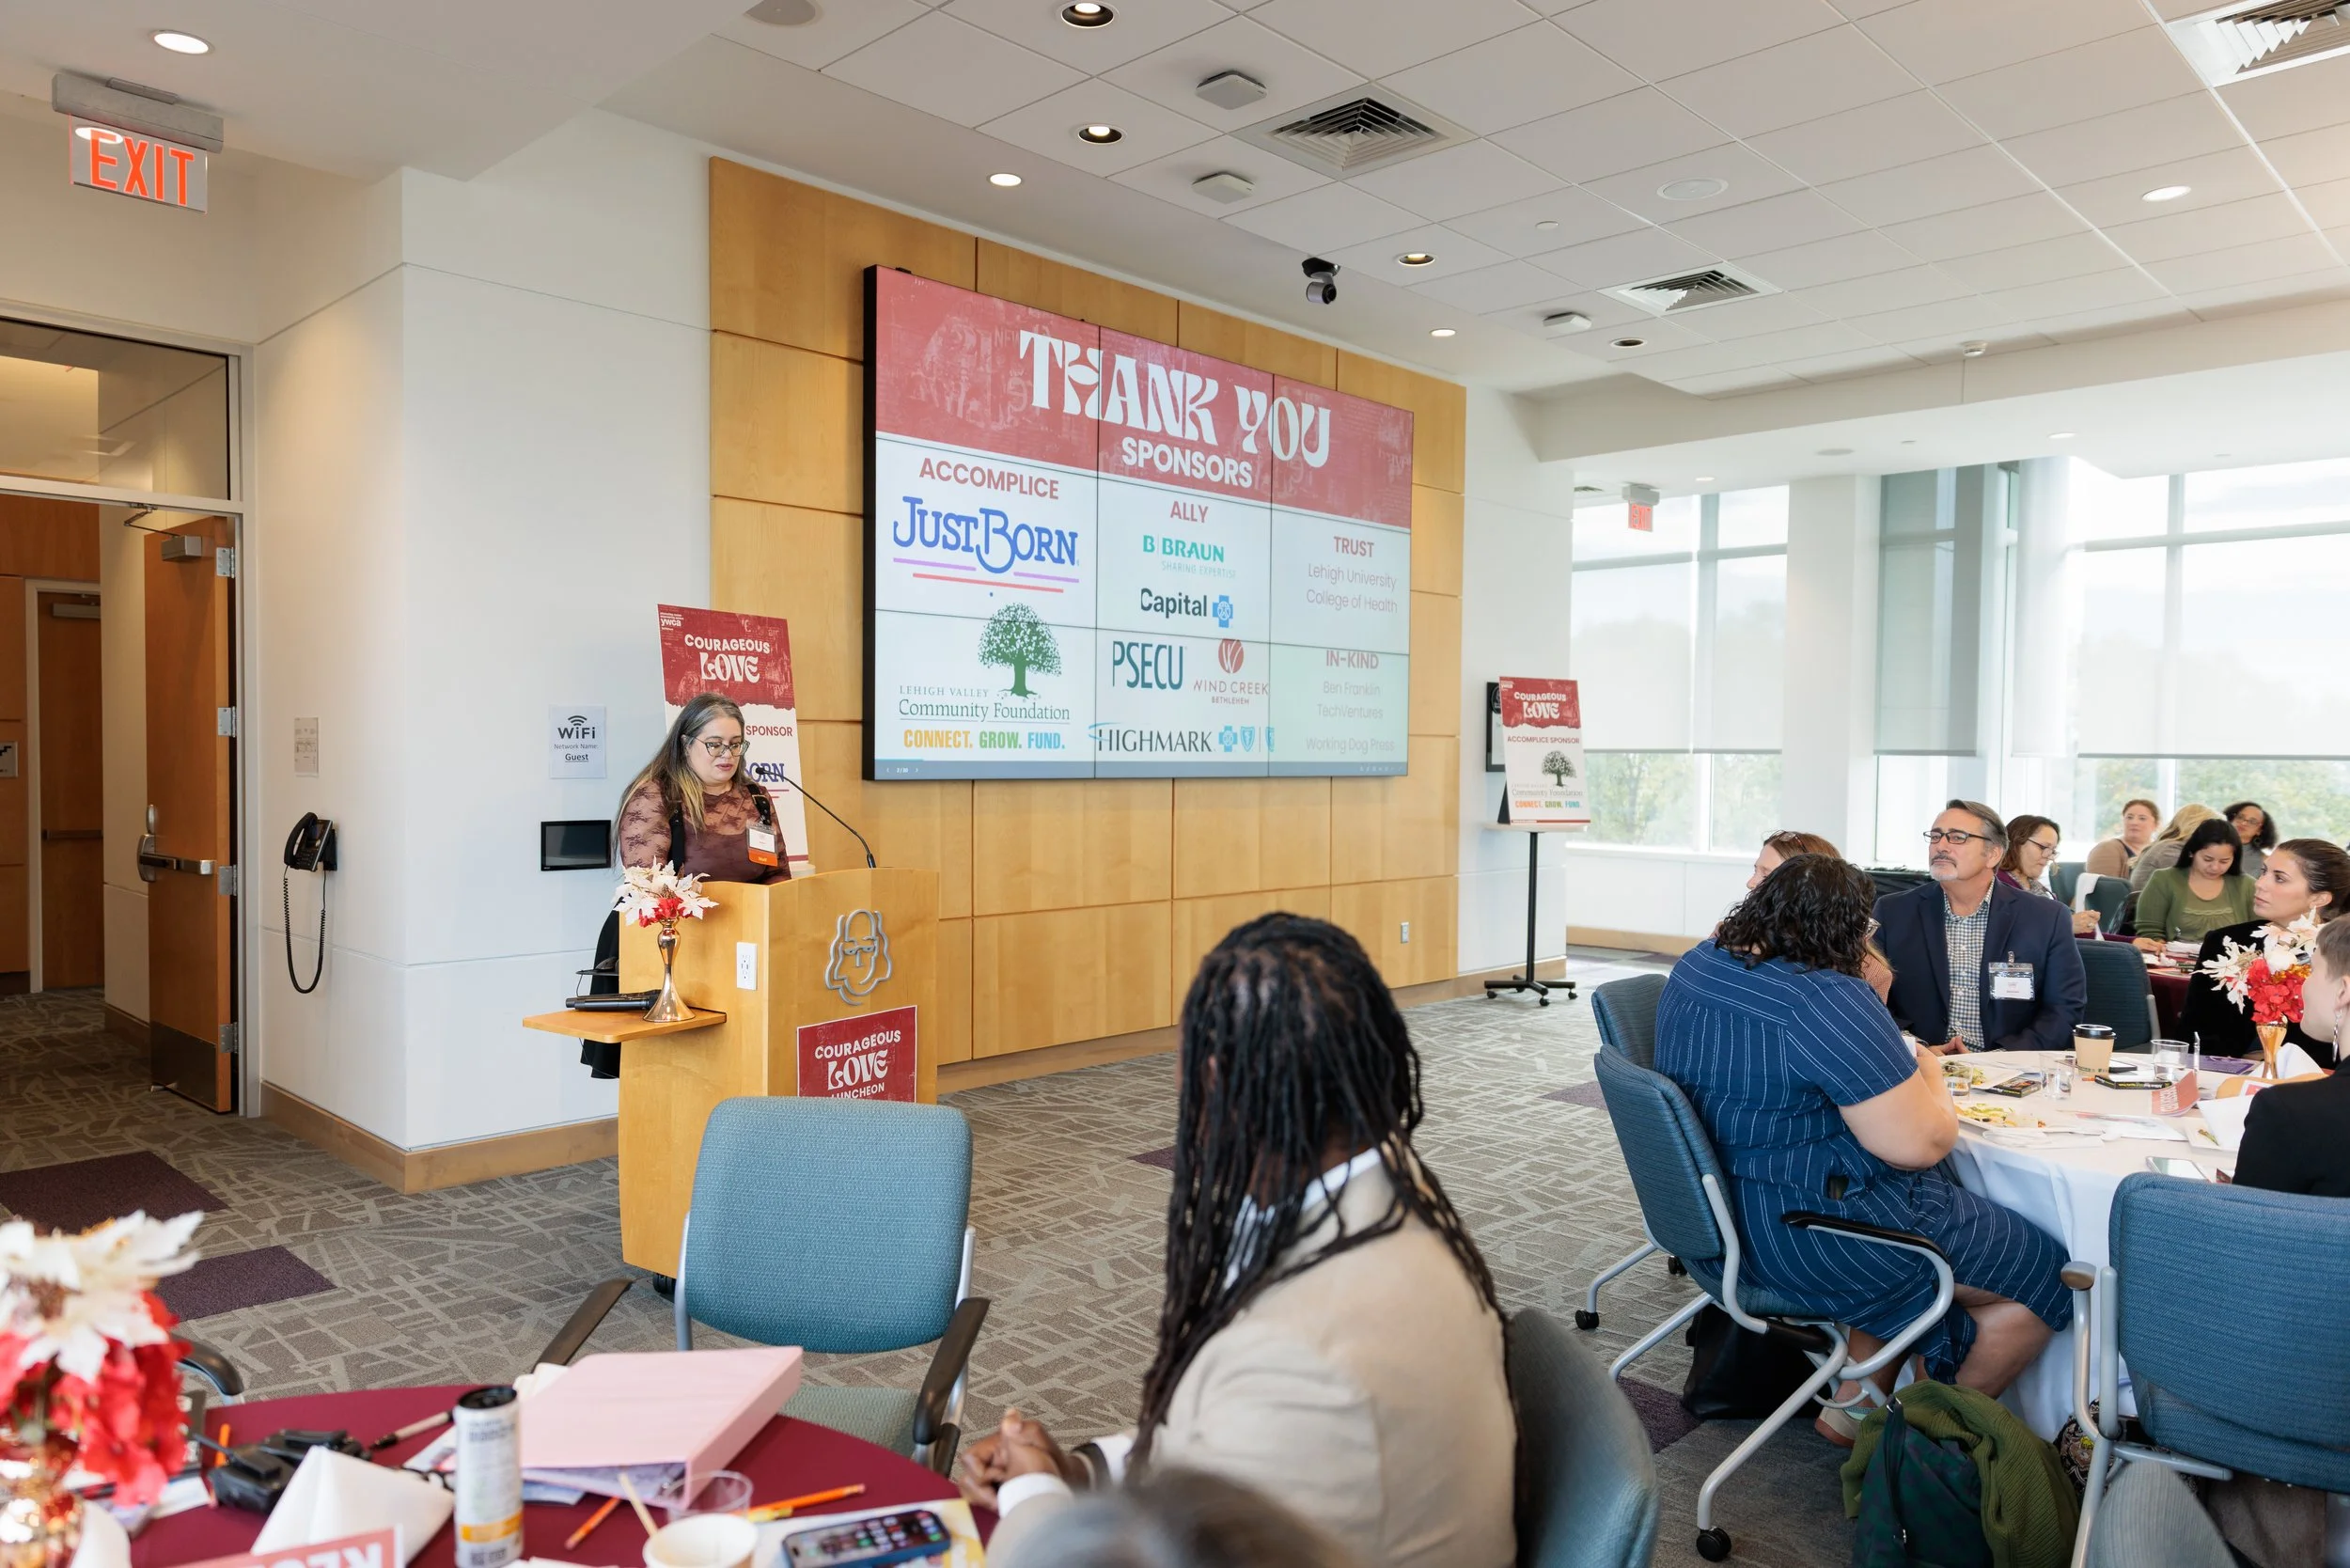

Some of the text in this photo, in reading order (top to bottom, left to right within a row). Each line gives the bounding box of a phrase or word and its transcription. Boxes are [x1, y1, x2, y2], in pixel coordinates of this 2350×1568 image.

[90, 129, 195, 206] EXIT
[1020, 330, 1330, 468] THANK YOU
[1122, 436, 1252, 488] SPONSORS
[919, 458, 1058, 499] ACCOMPLICE
[1170, 500, 1208, 523] ALLY
[1162, 538, 1224, 562] BRAUN
[1334, 536, 1374, 557] TRUST
[1162, 561, 1196, 574] SHARING
[1308, 563, 1397, 592] Lehigh University
[1141, 588, 1207, 619] Capital
[1307, 588, 1398, 613] College of Health
[661, 618, 682, 627] ywca
[684, 634, 771, 654] COURAGEOUS
[699, 652, 760, 684] LOVE
[1113, 641, 1183, 690] PSECU
[1326, 651, 1379, 669] IN-KIND
[900, 685, 989, 698] LEHIGH VALLEY
[1230, 682, 1269, 696] CREEK
[1513, 691, 1567, 701] COURAGEOUS
[899, 698, 1070, 722] Community Foundation
[1523, 701, 1560, 719] LOVE
[557, 727, 596, 739] WiFi
[745, 725, 793, 737] SPONSOR
[903, 729, 1065, 749] CONNECT. GROW. FUND.
[1098, 729, 1213, 752] HIGHMARK
[565, 753, 589, 762] Guest
[815, 1029, 901, 1059] COURAGEOUS
[828, 1049, 888, 1090] LOVE
